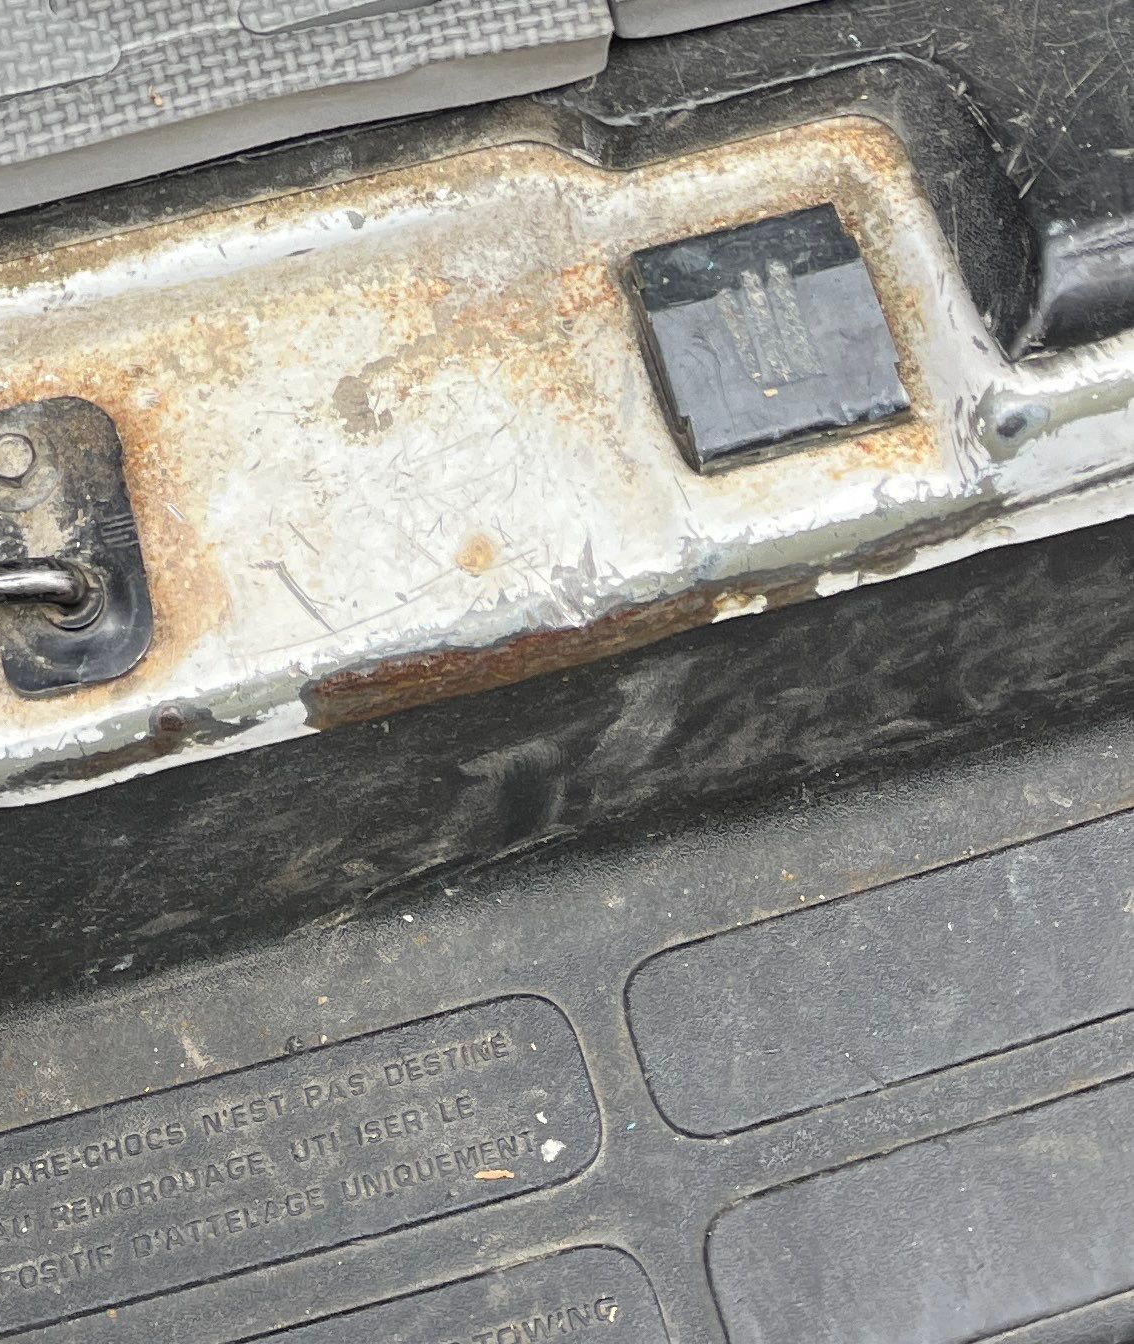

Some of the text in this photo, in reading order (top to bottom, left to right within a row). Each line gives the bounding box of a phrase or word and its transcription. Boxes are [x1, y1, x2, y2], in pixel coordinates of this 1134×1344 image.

[201, 1093, 286, 1136] N'EST
[303, 1073, 367, 1109] PAS
[290, 1109, 424, 1163] UTIISER
[437, 1095, 475, 1124] LE
[132, 1187, 326, 1259] D'ATTELAGE
[341, 1130, 534, 1202] UNIQUEMENT
